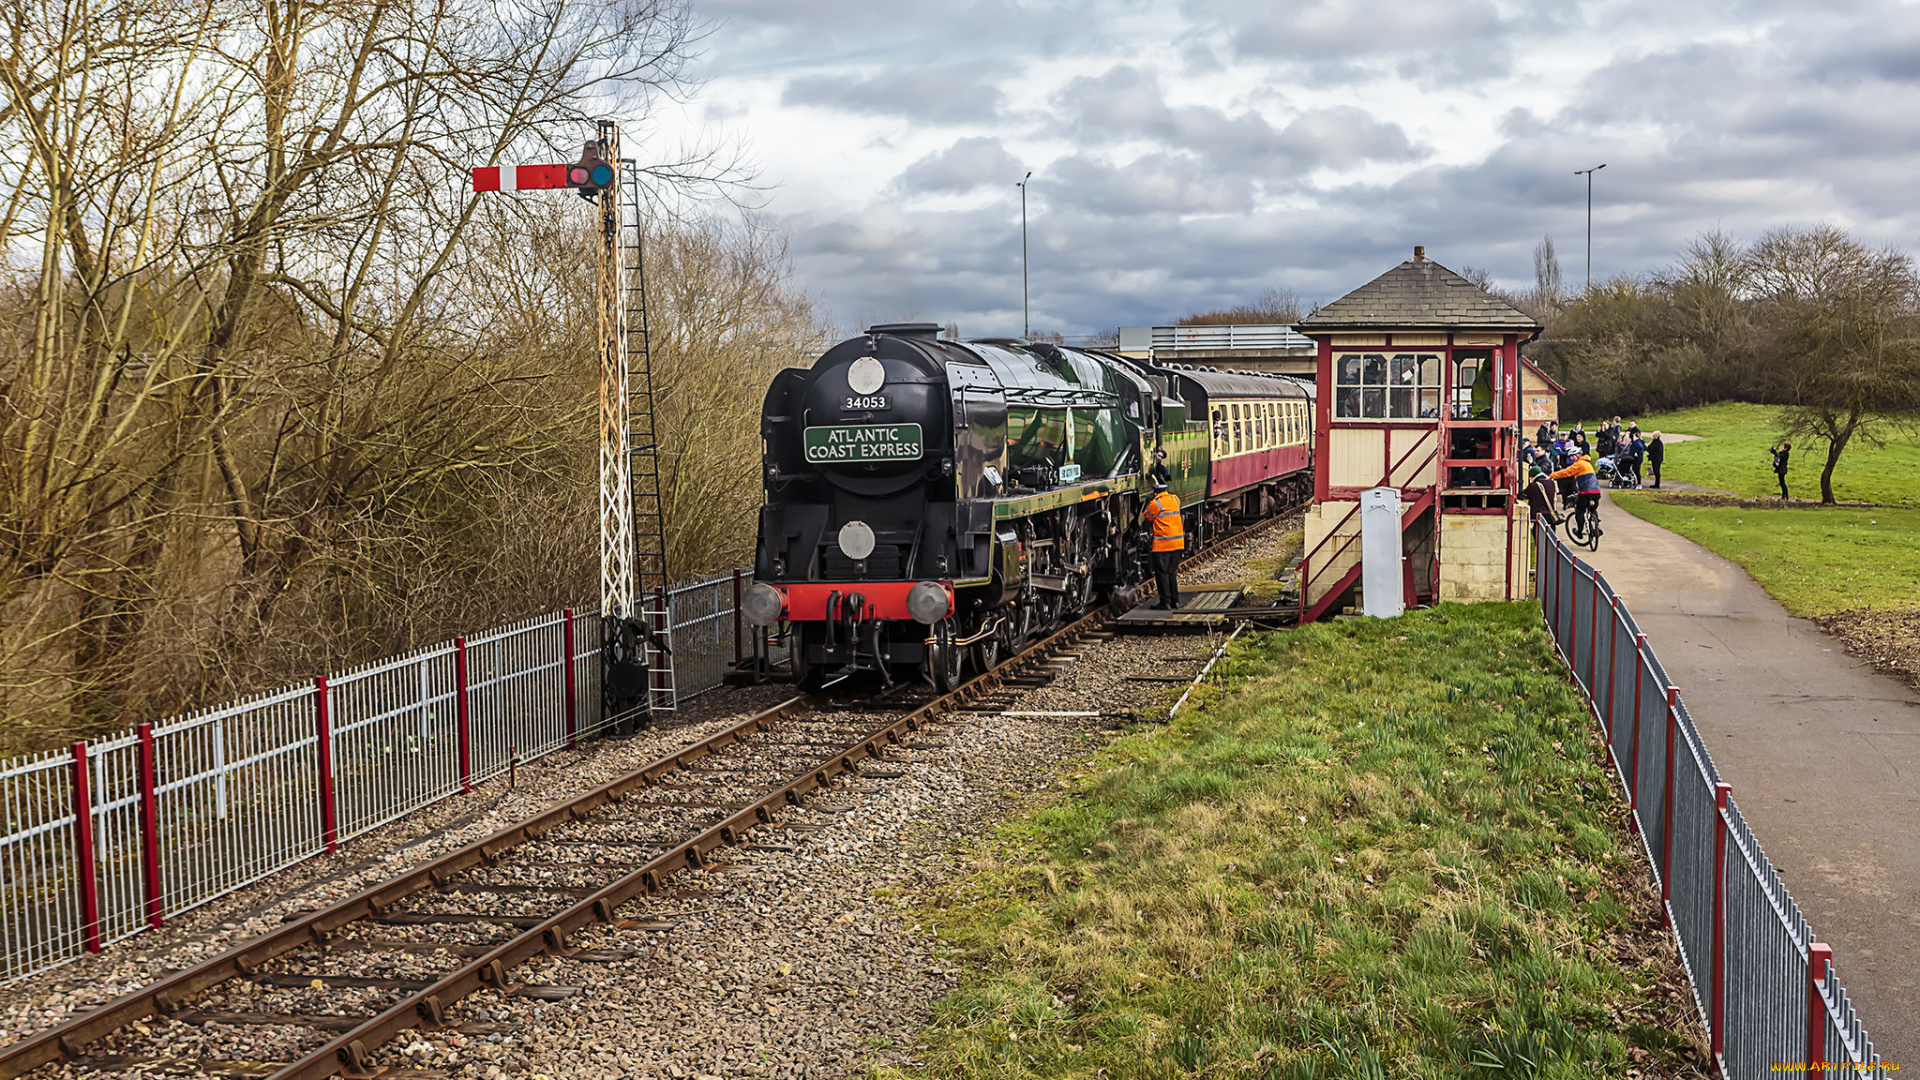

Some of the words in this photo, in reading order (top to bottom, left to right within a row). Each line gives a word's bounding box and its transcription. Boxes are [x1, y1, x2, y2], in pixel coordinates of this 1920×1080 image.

[846, 397, 886, 408] 34053
[828, 428, 899, 443] ATLANTIC
[809, 444, 856, 458] COAST
[861, 443, 919, 457] EXPRESS
